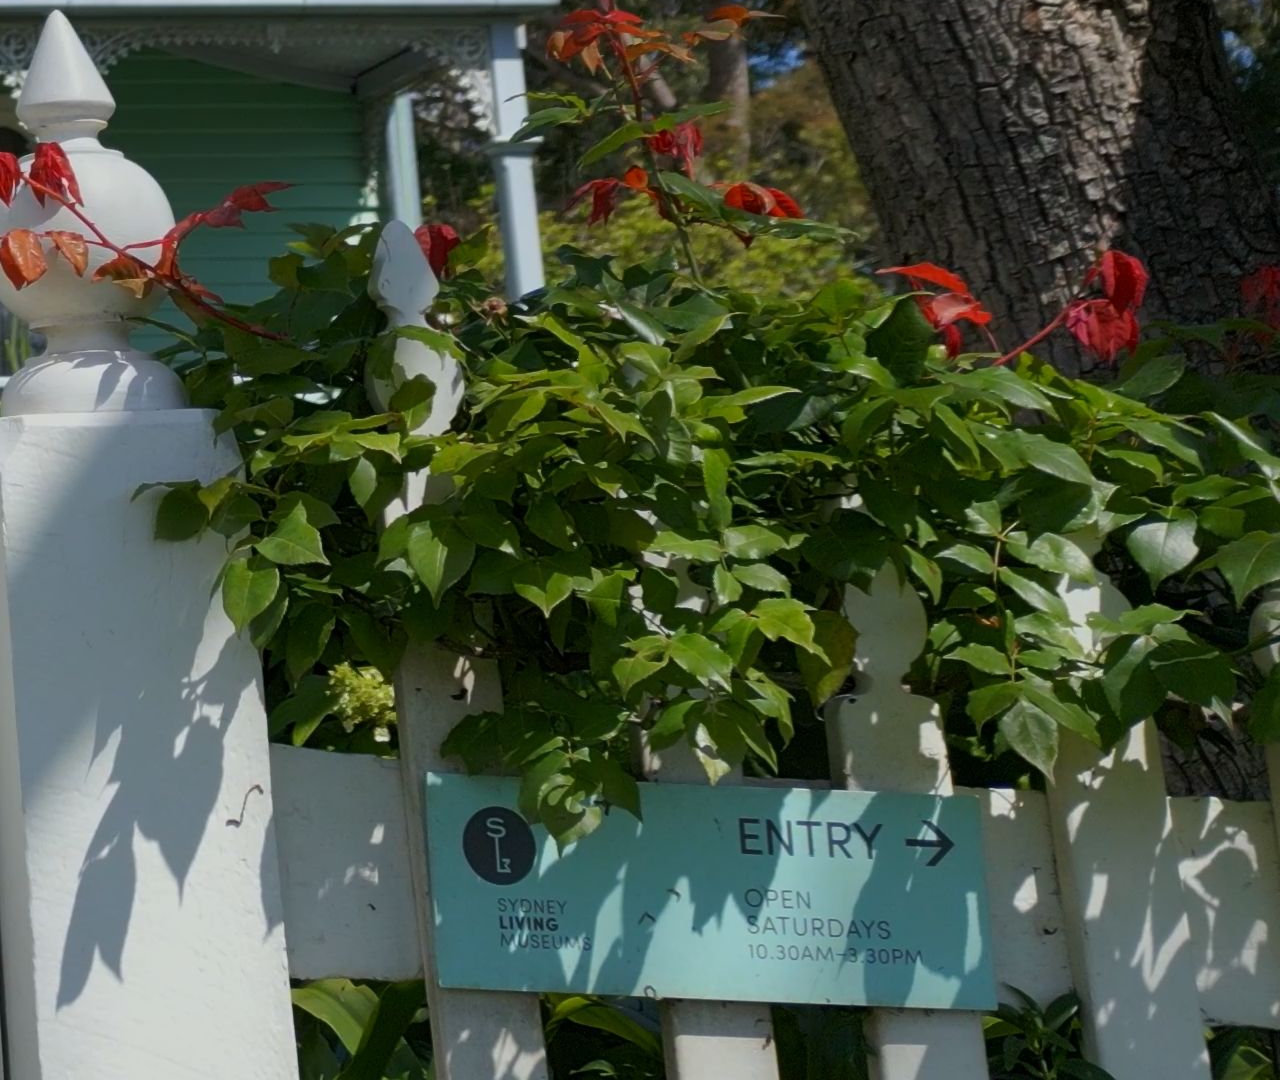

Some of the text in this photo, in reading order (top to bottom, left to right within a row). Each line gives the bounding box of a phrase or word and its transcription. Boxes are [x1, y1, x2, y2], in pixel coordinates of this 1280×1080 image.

[738, 817, 883, 860] ENTRY
[497, 897, 568, 915] SYDNEY
[744, 888, 812, 911] OPEN
[499, 915, 559, 932] LIVING
[746, 915, 892, 941] SATURDAYS
[500, 932, 593, 952] MUSEUMS
